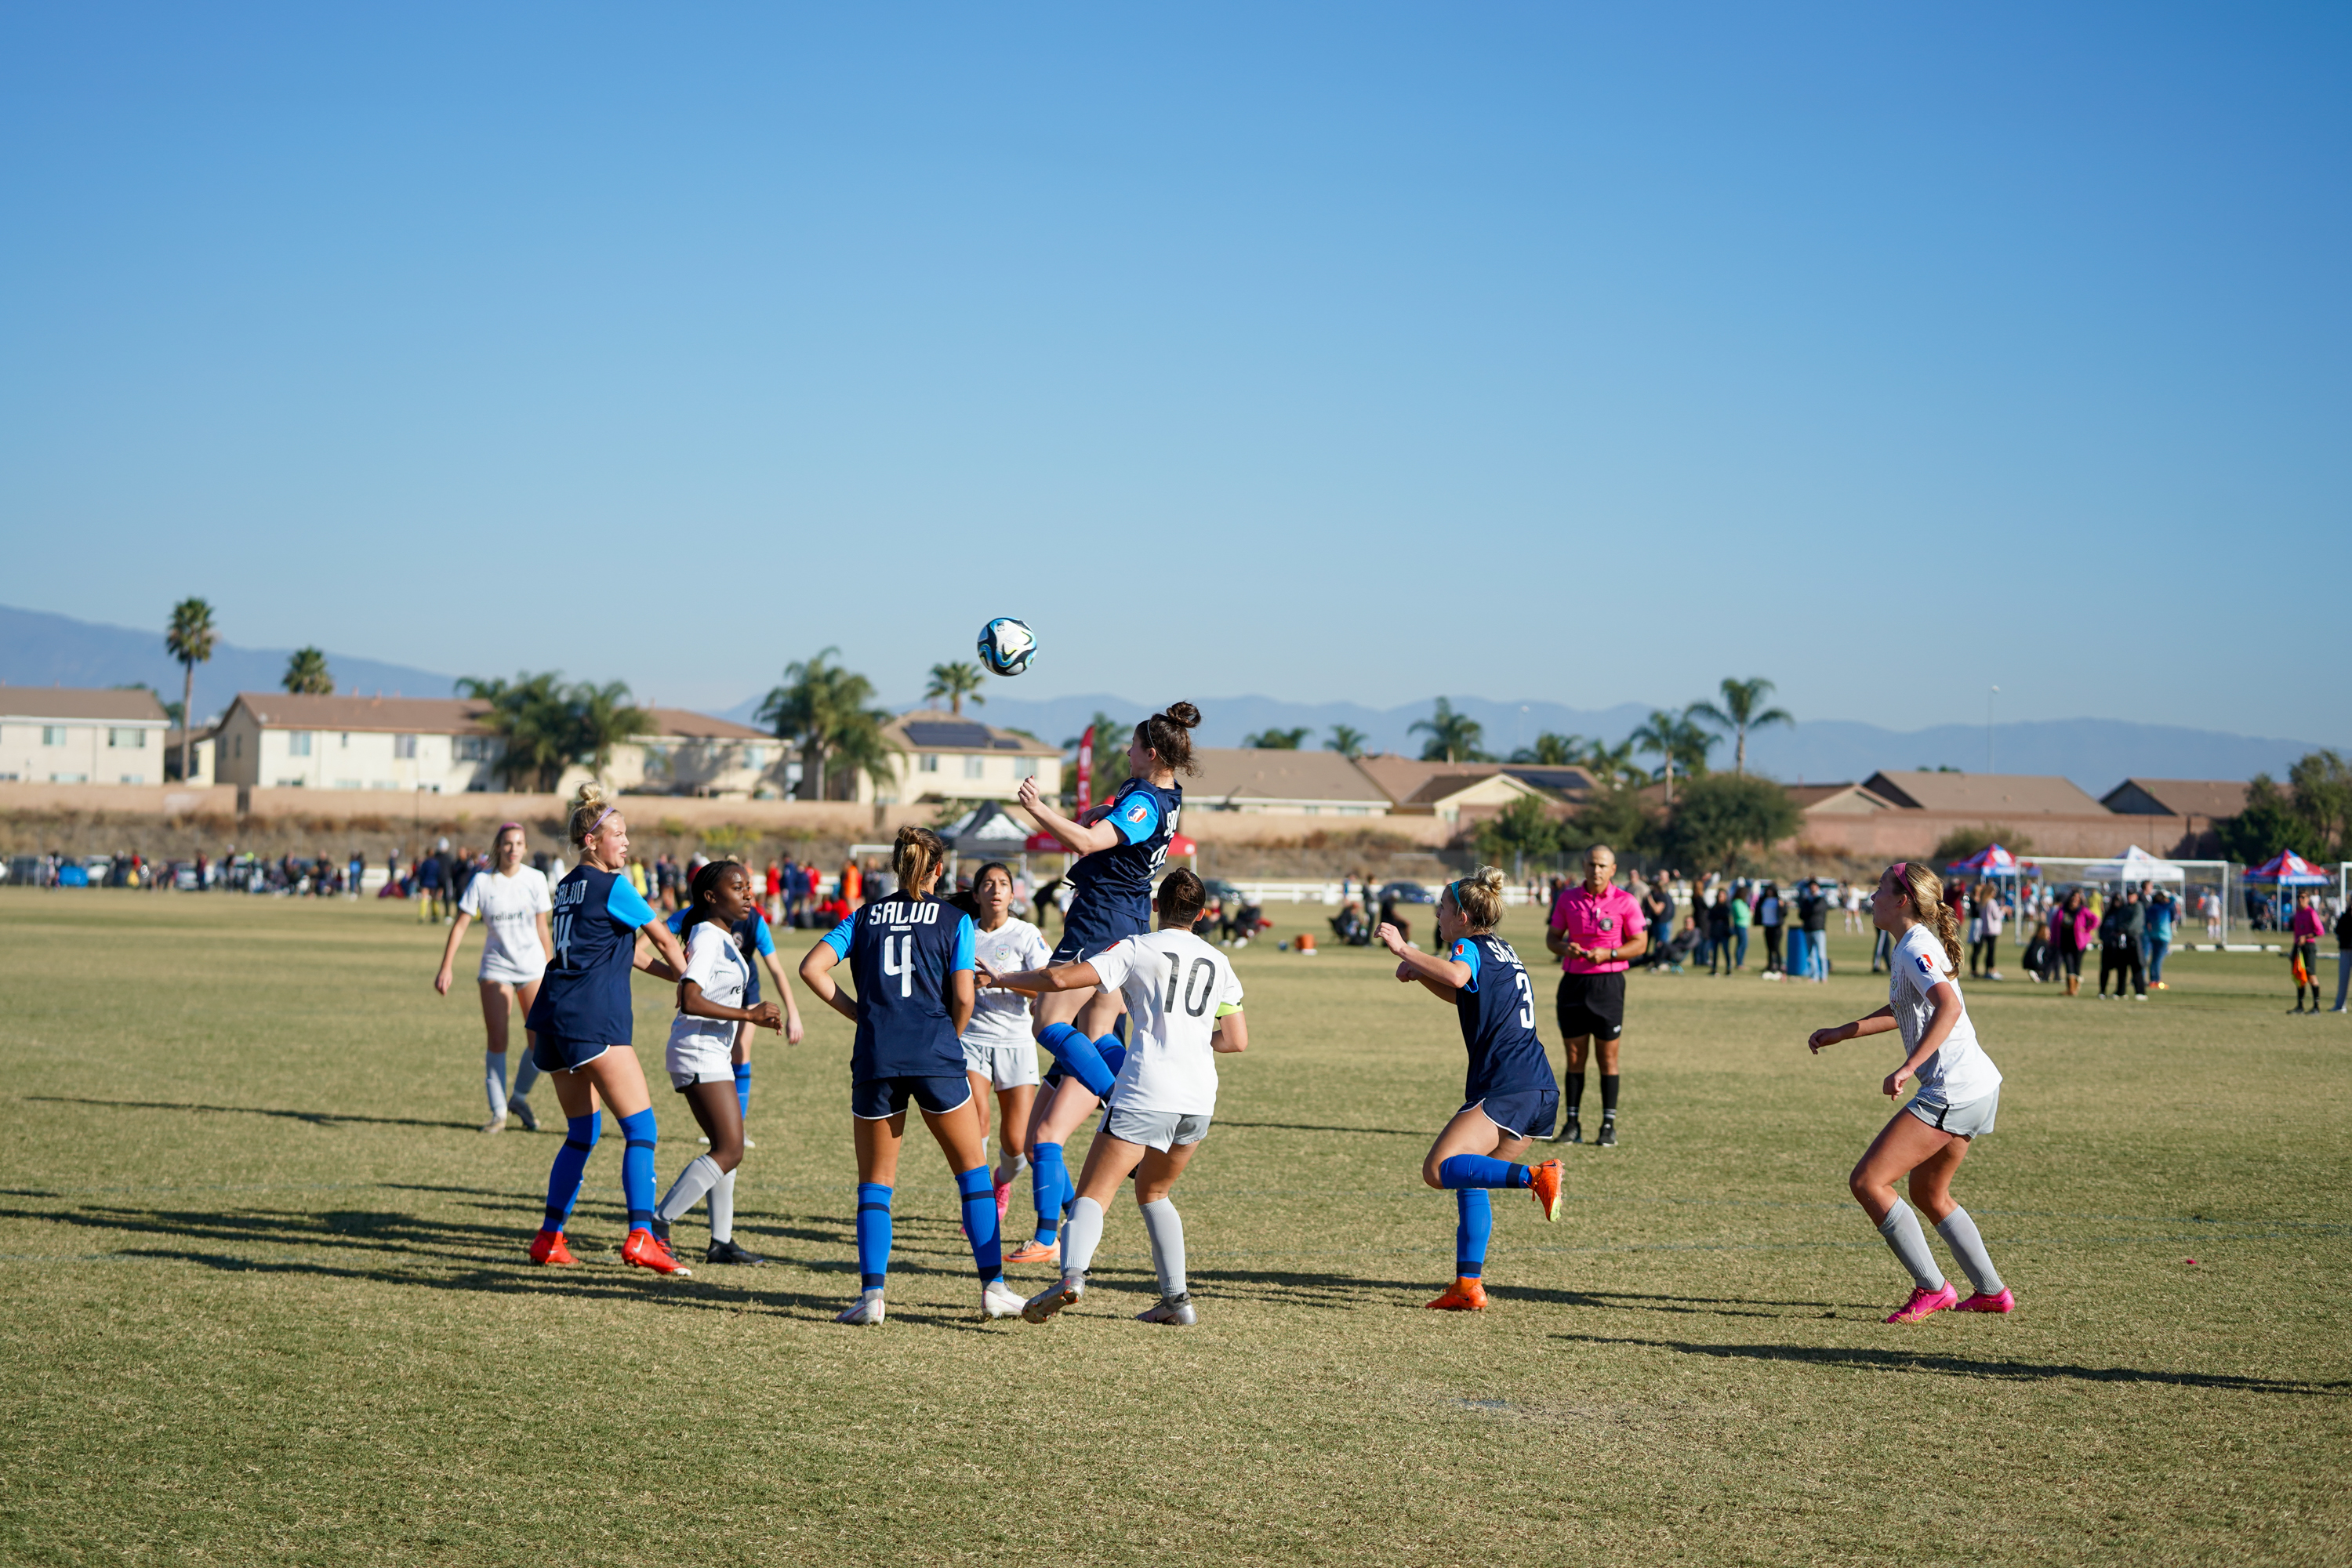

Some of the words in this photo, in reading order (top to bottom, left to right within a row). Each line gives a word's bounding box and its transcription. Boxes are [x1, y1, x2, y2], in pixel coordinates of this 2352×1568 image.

[491, 911, 523, 922] reliant
[554, 913, 573, 969] 14
[884, 935, 916, 997] 4
[1161, 951, 1216, 1017] 10
[1515, 972, 1535, 1029] 3
